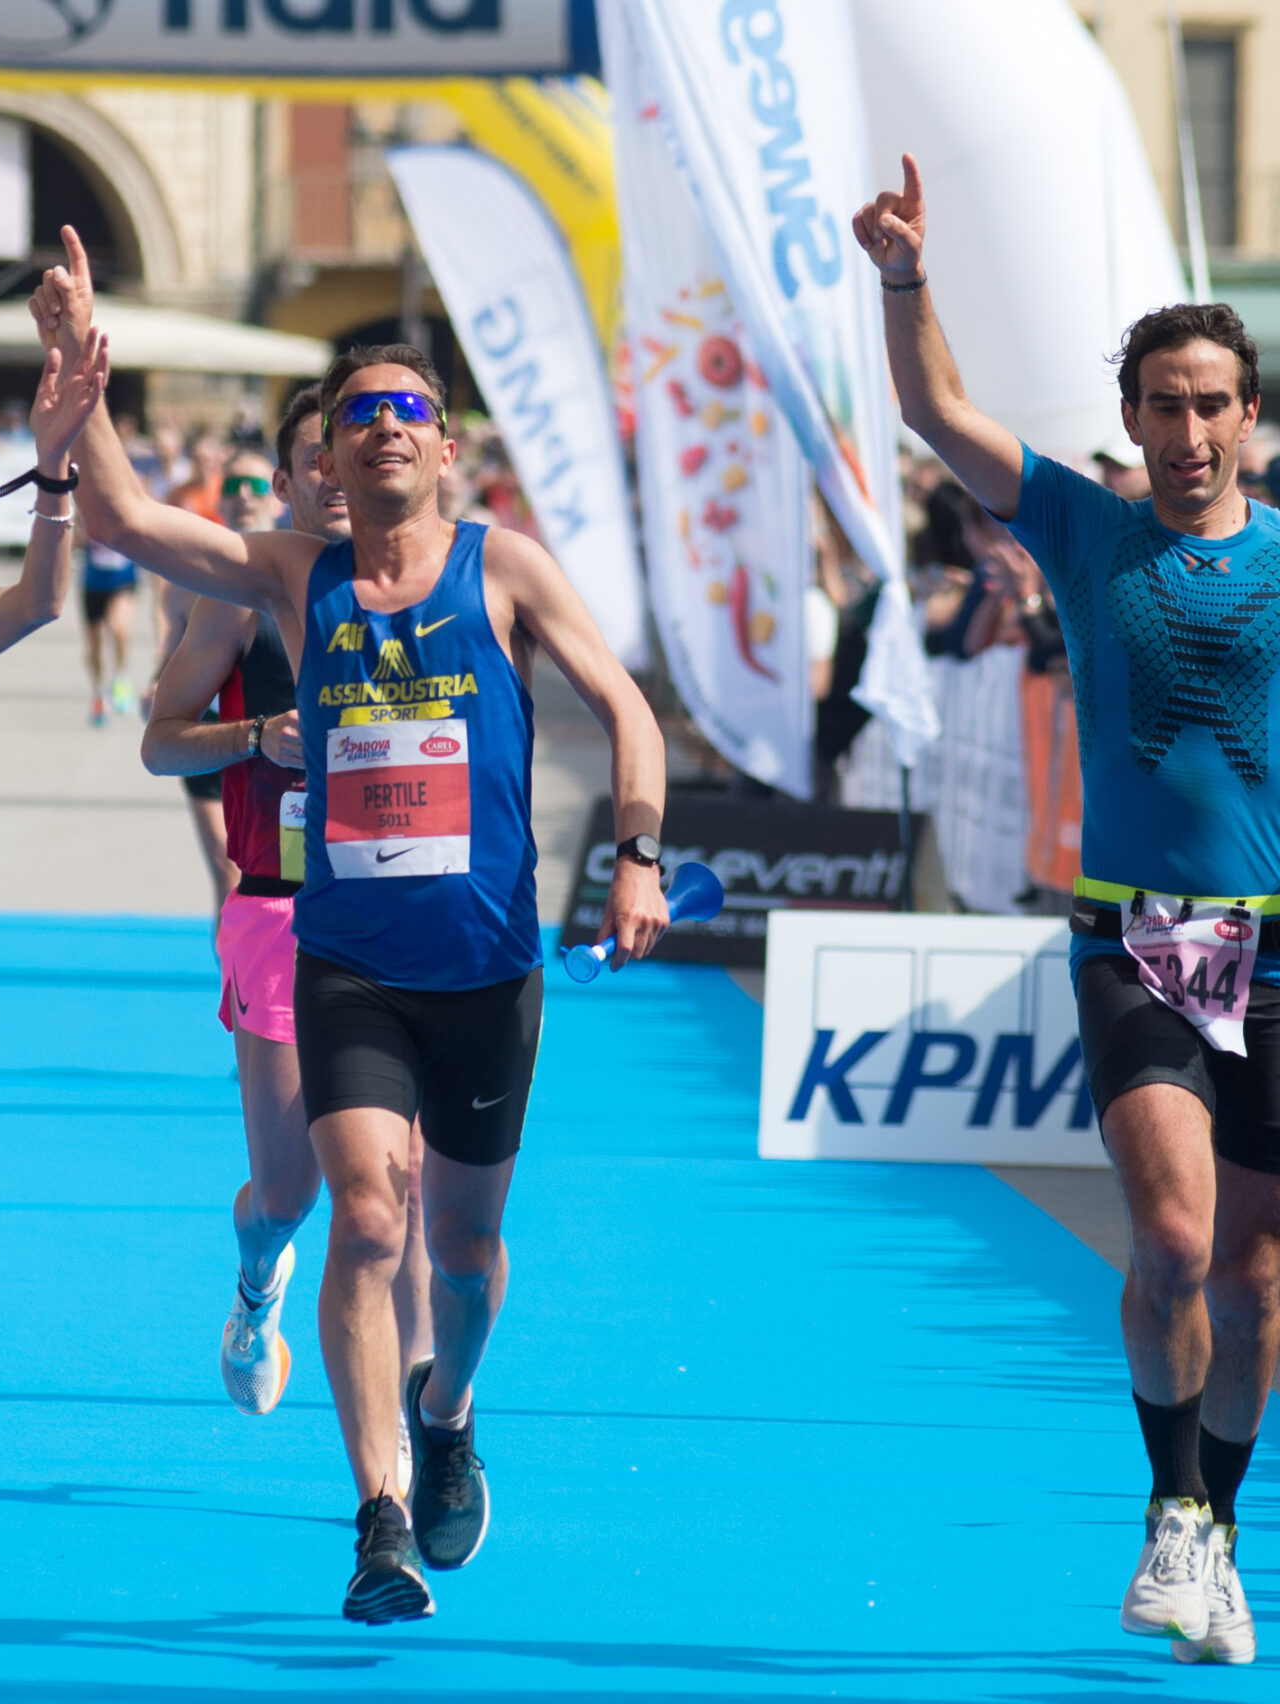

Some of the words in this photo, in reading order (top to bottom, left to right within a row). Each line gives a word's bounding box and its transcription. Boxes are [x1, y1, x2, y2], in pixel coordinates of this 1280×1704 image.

[318, 673, 479, 706] ASSINDUSTRIA
[369, 706, 420, 723] SPORT
[349, 739, 391, 753] PADOVA
[425, 741, 454, 752] CAREL
[363, 780, 428, 811] PERTILE
[377, 811, 412, 828] 5011
